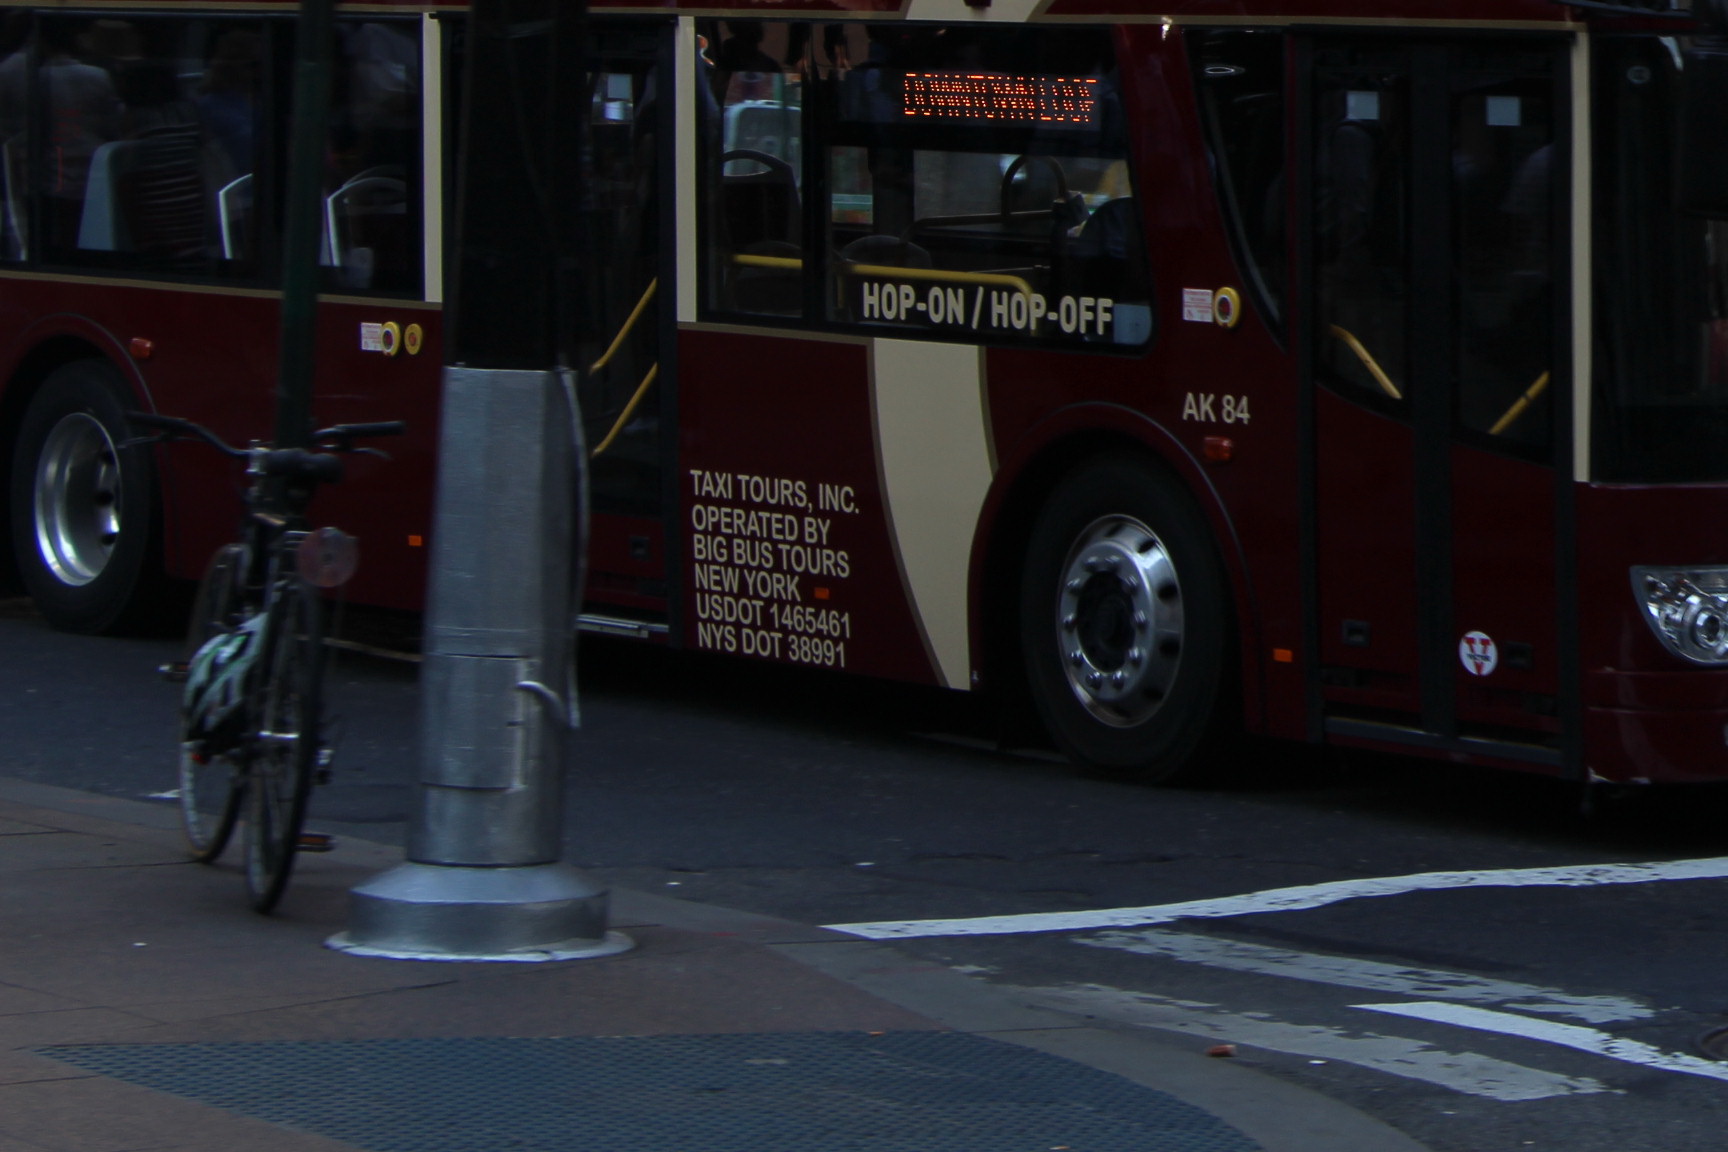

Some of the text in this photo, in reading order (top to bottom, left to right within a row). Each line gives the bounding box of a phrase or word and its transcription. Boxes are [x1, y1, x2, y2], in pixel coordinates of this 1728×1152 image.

[862, 281, 965, 326] HOP-ON
[990, 290, 1114, 336] HOP-OFF
[1182, 391, 1251, 425] AK 84
[689, 469, 860, 515] TAXI TOURS, INC.
[691, 504, 831, 546] OPERATED BY
[693, 533, 850, 579] BIG BUS TOURS
[694, 562, 802, 602] NEW YORK
[696, 592, 851, 639] USDOT 1465461
[697, 621, 845, 669] NYS DOT 38991
